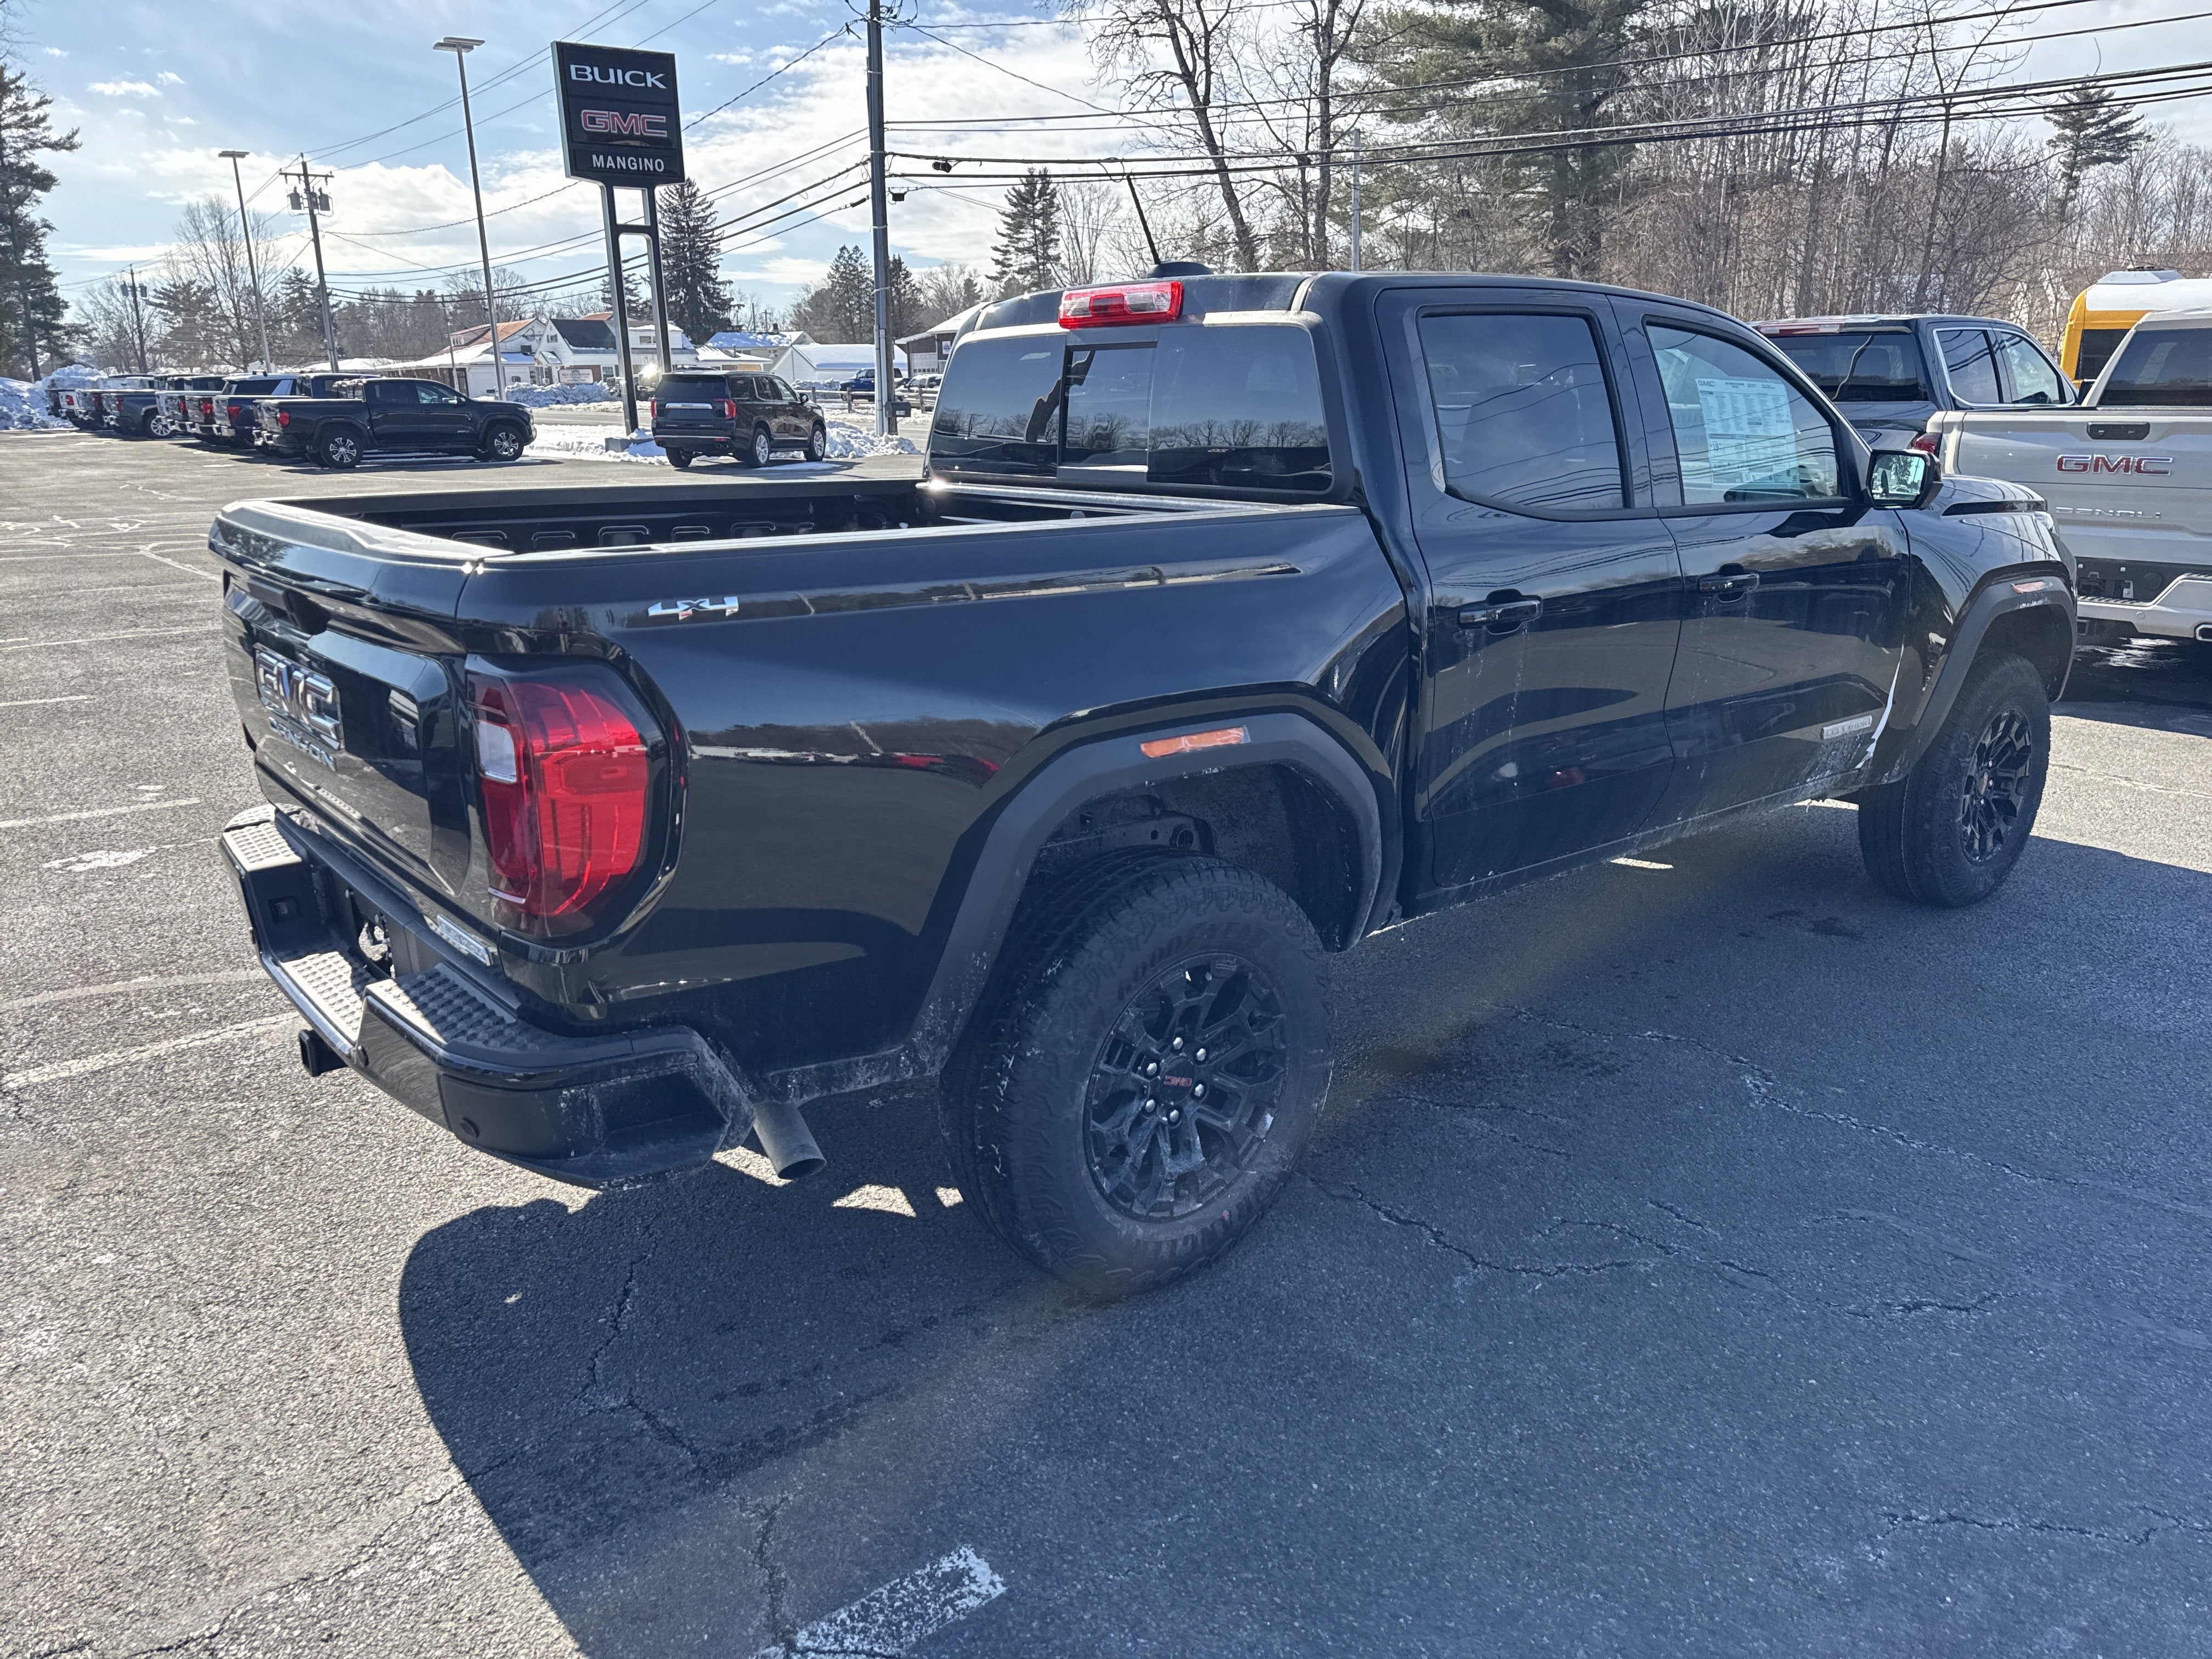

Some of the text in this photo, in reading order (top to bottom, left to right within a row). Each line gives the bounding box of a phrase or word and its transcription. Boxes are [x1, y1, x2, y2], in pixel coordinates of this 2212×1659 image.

[569, 64, 667, 89] BUICK
[581, 109, 667, 138] GMC
[592, 154, 664, 172] MANGINO
[2056, 453, 2173, 476] GMC
[2056, 506, 2161, 518] DENALI
[255, 647, 345, 751] GMC
[268, 716, 337, 771] CANYON
[1163, 1075, 1192, 1086] GMC
